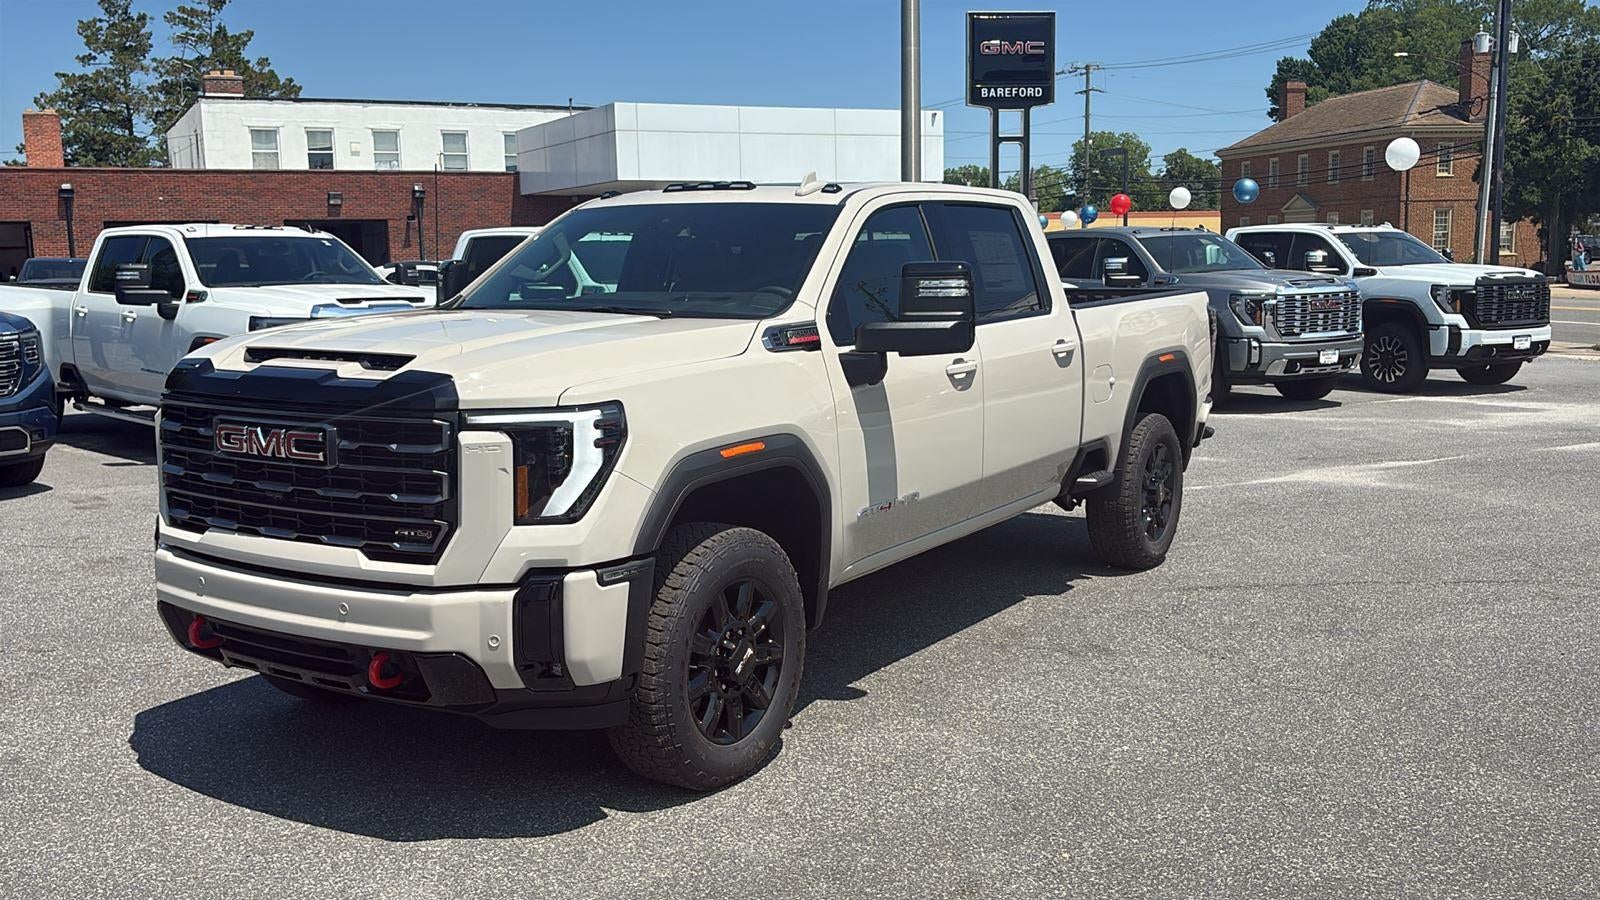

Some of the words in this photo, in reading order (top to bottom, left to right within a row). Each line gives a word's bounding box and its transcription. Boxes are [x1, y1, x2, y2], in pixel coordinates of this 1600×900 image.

[980, 40, 1045, 55] GMC
[981, 87, 1043, 98] BAREFORD
[215, 422, 325, 462] GMC
